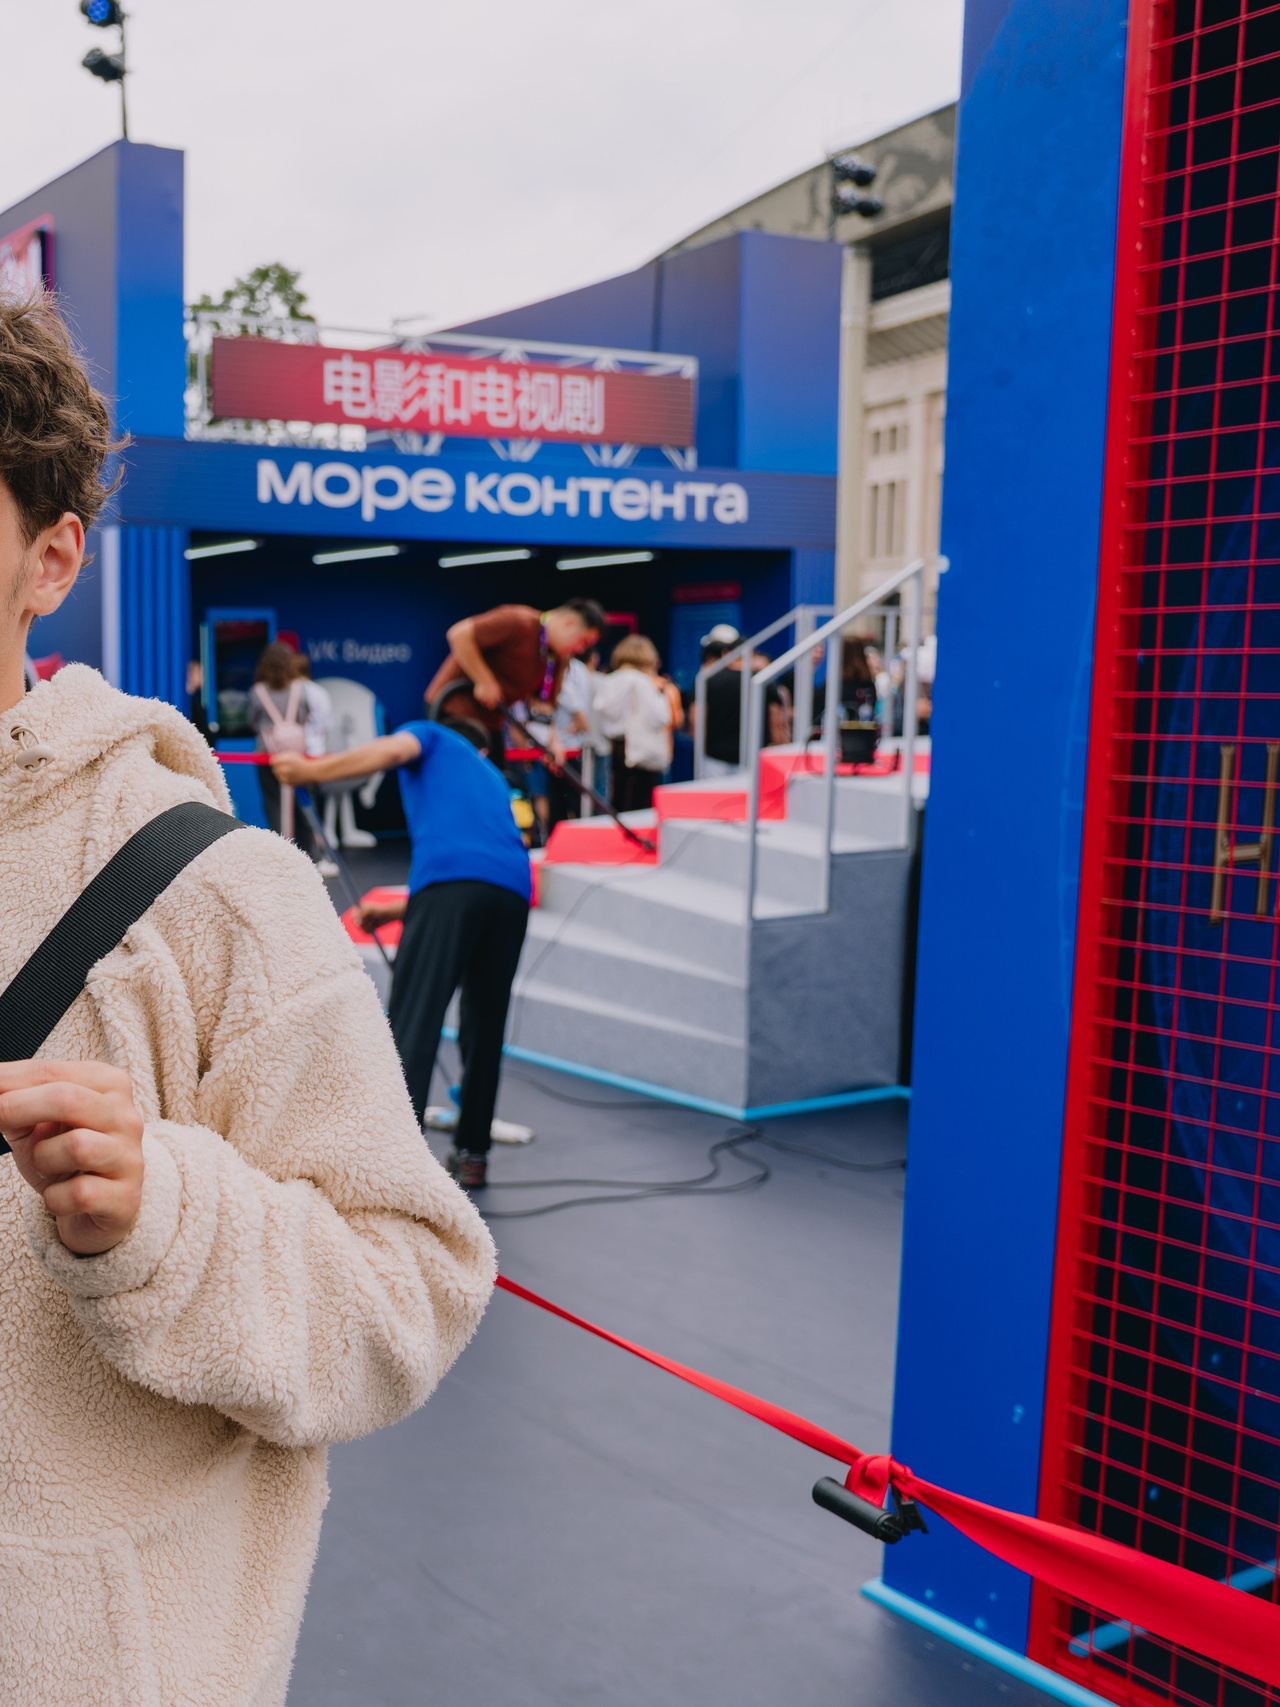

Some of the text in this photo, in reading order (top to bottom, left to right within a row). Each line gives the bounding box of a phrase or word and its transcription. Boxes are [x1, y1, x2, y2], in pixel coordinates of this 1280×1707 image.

[323, 353, 605, 435] 电影和电视剧
